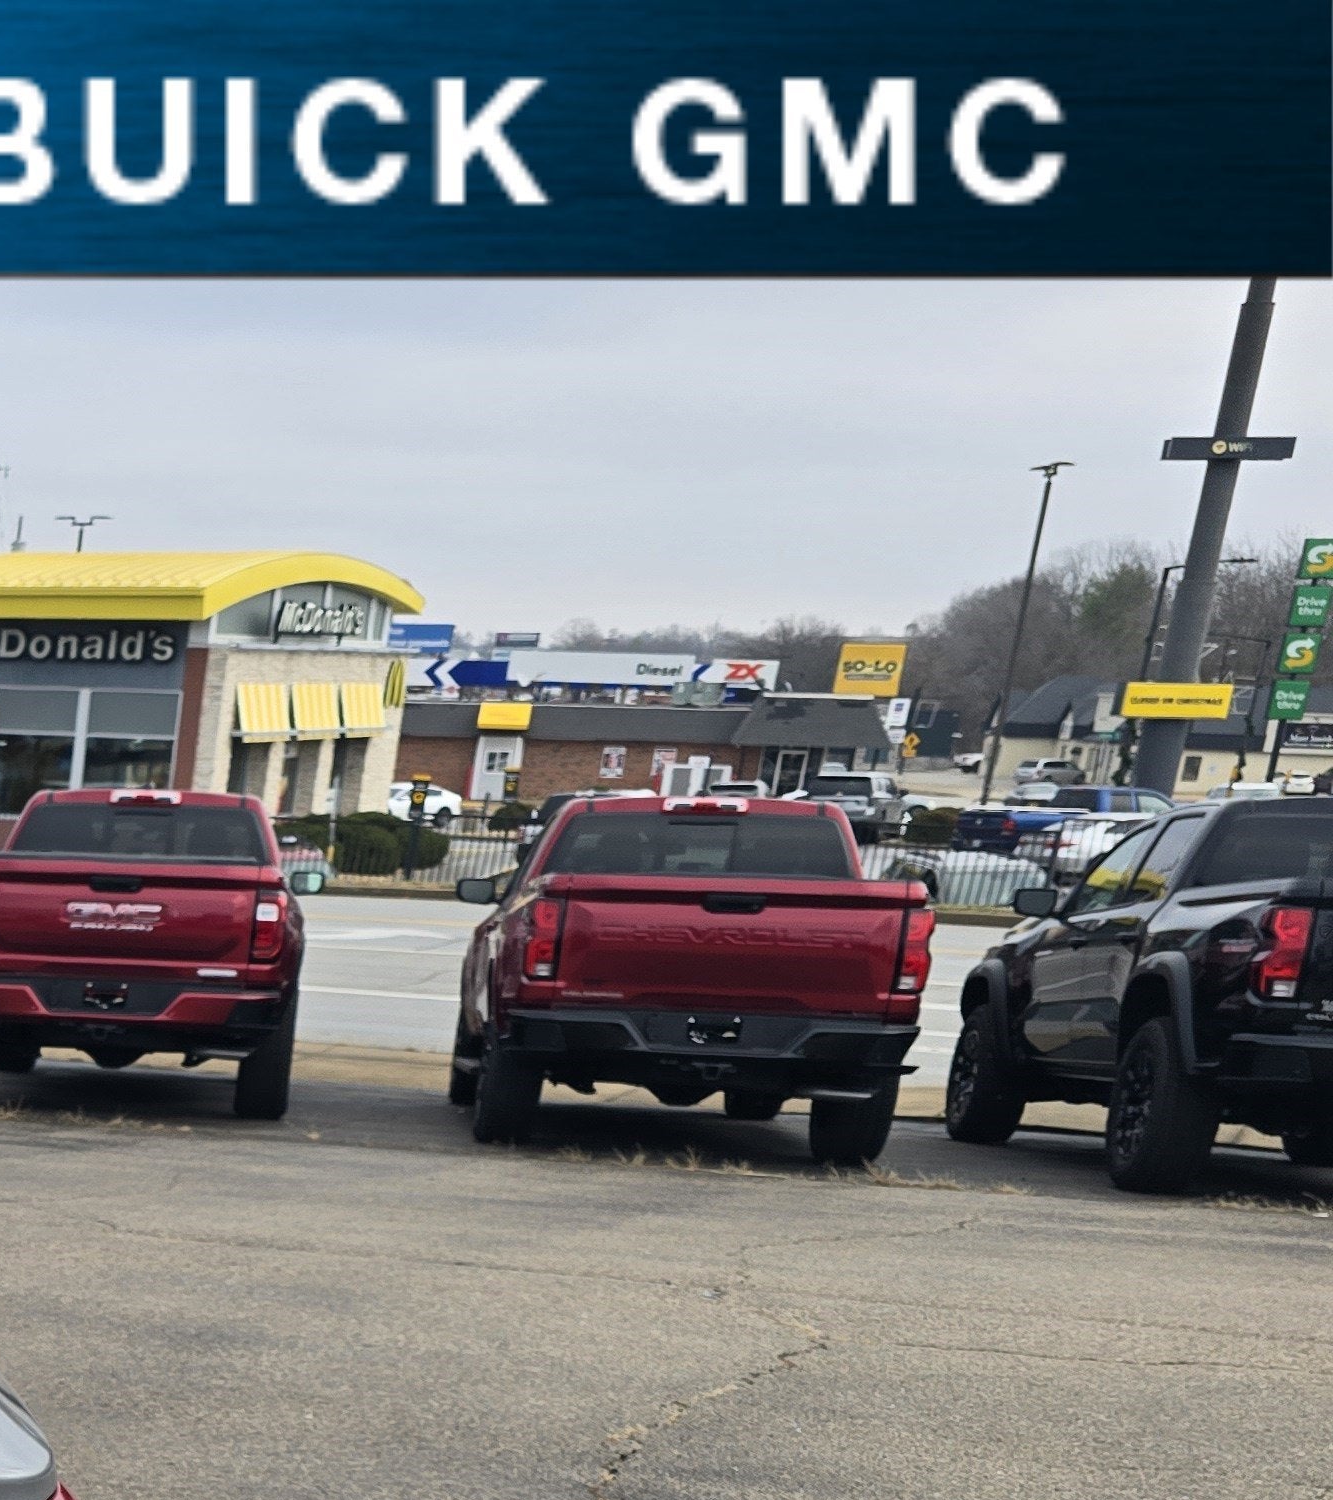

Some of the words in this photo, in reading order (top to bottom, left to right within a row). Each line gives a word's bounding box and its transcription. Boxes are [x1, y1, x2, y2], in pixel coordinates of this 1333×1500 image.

[1296, 596, 1328, 608] Drive
[278, 600, 366, 634] McDonald's
[635, 663, 684, 677] Diesel
[1275, 690, 1306, 702] Drive
